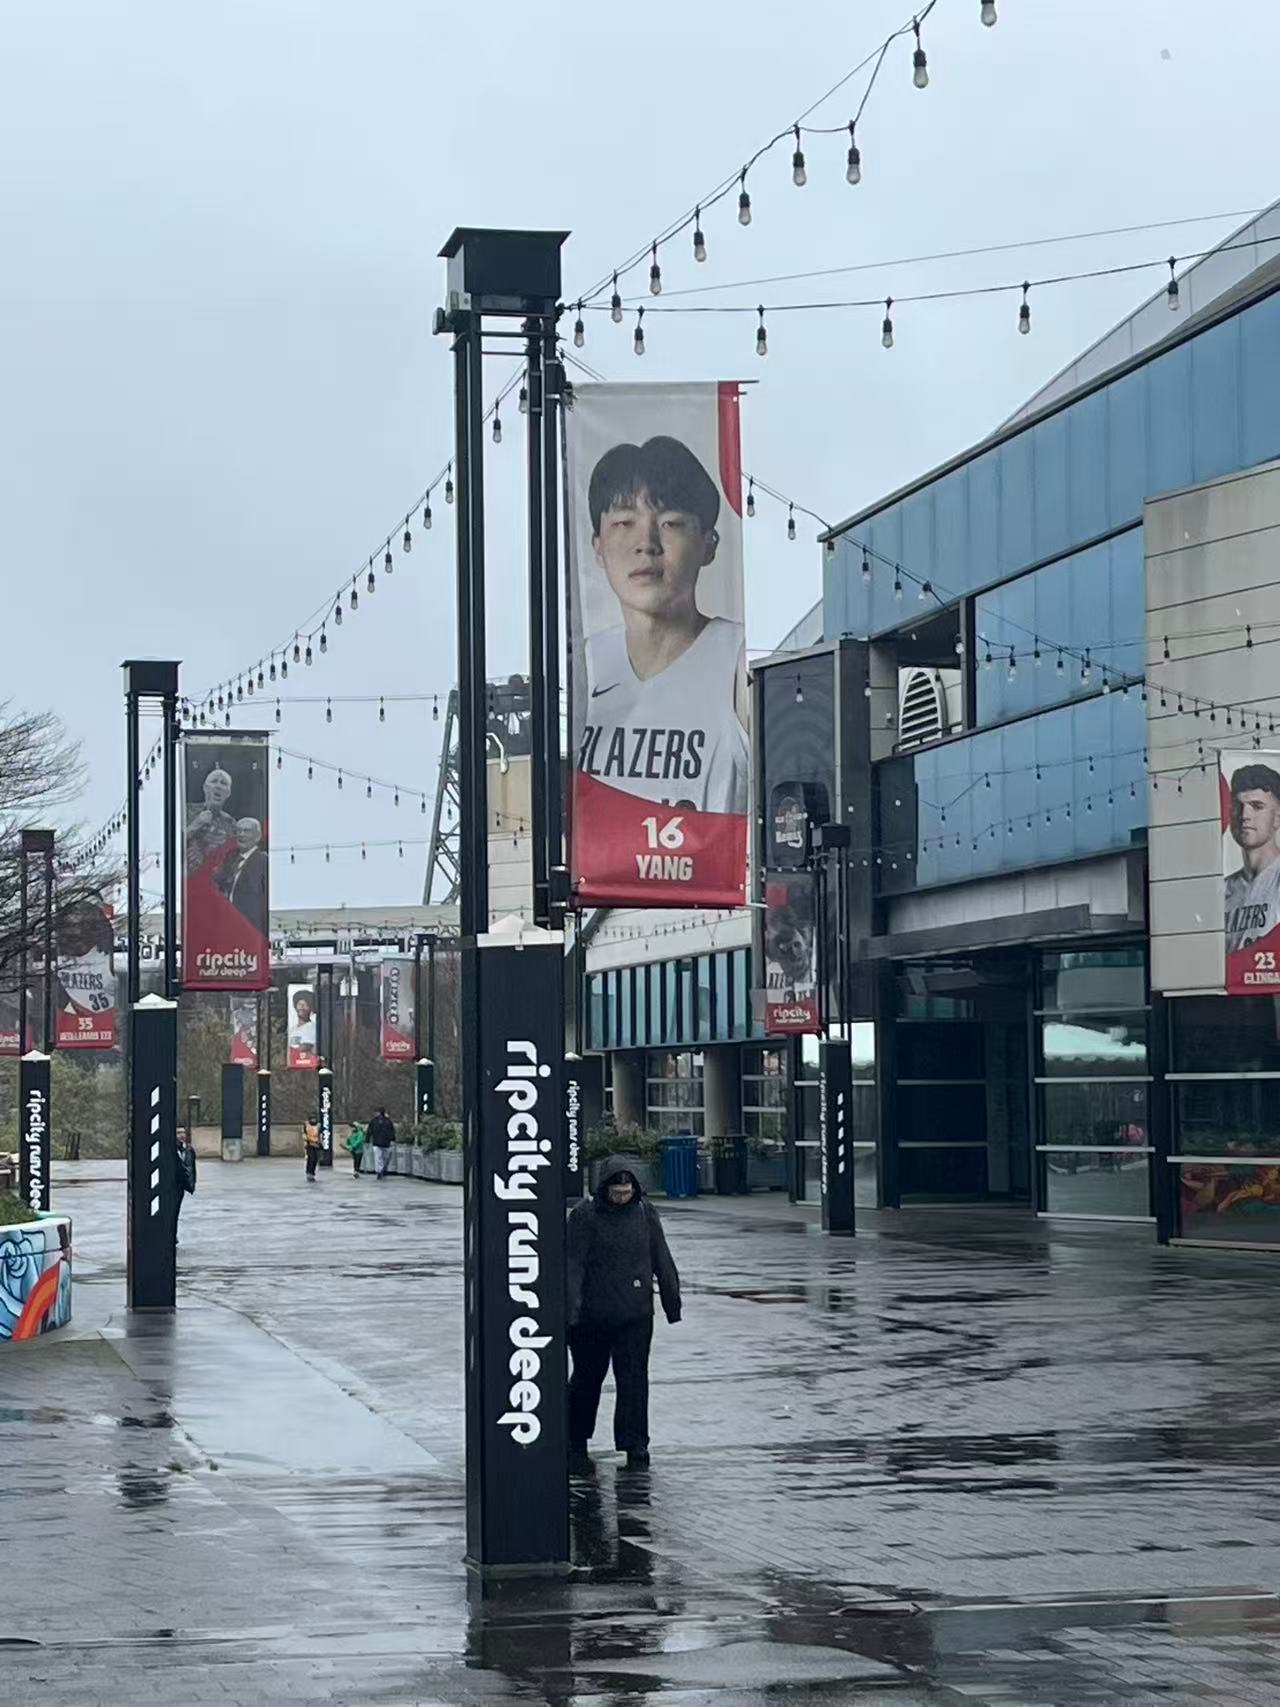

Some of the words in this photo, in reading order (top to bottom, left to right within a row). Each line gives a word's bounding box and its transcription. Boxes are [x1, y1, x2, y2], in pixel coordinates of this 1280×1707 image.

[641, 816, 685, 849] 16
[635, 854, 693, 881] YANG
[196, 948, 258, 972] ripcity
[220, 967, 247, 978] deep
[1254, 952, 1276, 970] 23
[88, 993, 110, 1012] 35
[773, 1006, 811, 1020] ripcity
[566, 1080, 580, 1117] ripcity
[25, 1090, 46, 1142] ripcity
[494, 1040, 551, 1200] ripcity
[569, 1119, 578, 1141] runs
[29, 1145, 41, 1177] runs
[567, 1142, 580, 1172] deep
[29, 1178, 45, 1209] dee
[508, 1211, 539, 1308] runs
[496, 1316, 553, 1445] deep
